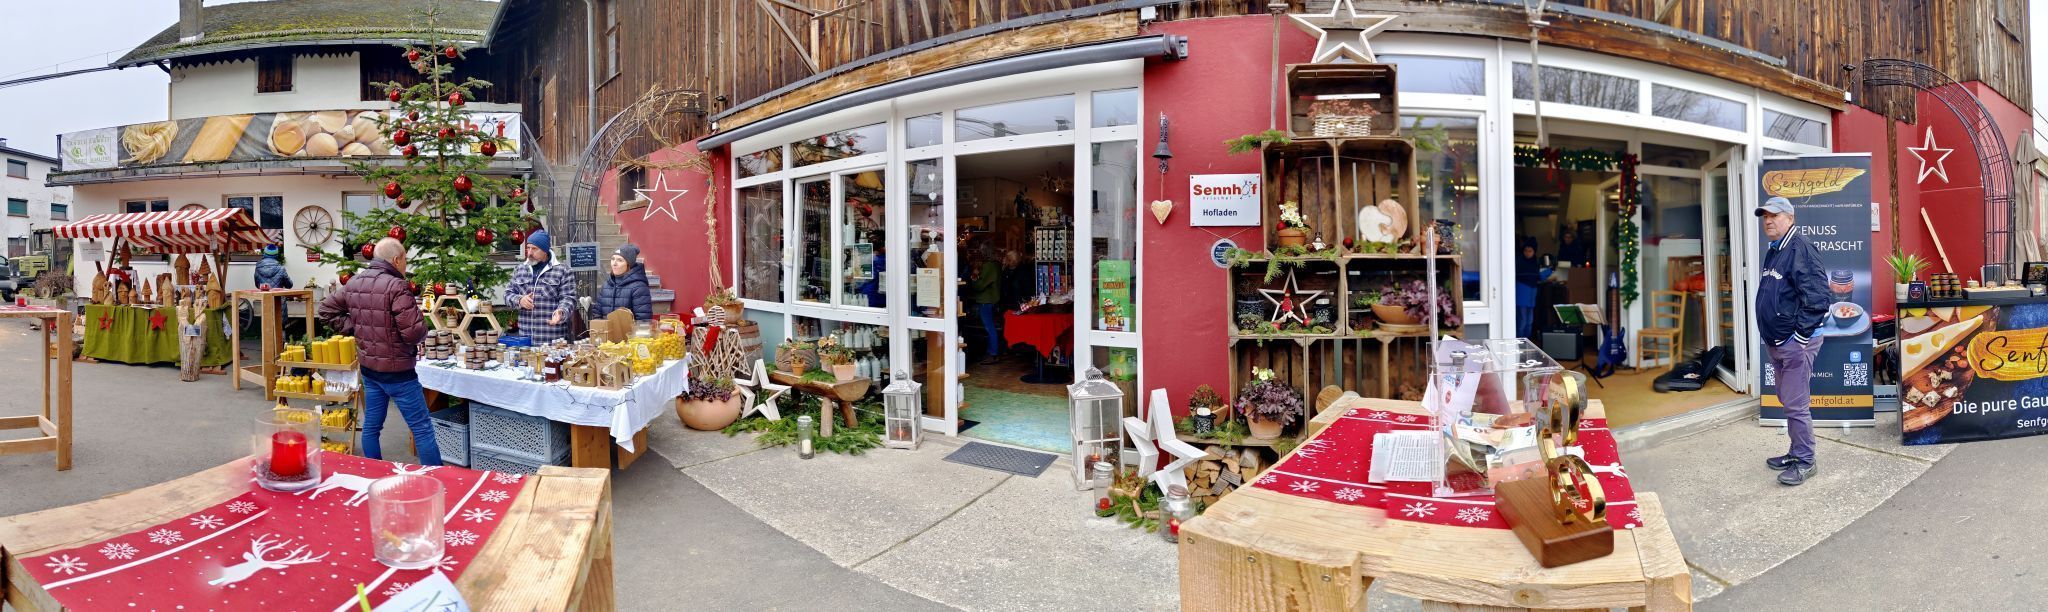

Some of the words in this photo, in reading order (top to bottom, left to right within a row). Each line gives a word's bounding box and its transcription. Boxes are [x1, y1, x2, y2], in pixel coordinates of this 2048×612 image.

[1193, 183, 1258, 197] Sennhof
[1769, 167, 1845, 204] Senfgold
[1813, 240, 1864, 252] RRASCHT
[1810, 396, 1855, 407] enfgold.at
[1953, 400, 1978, 415] Die
[1981, 399, 2018, 416] pure
[2017, 417, 2048, 428] Senfg
